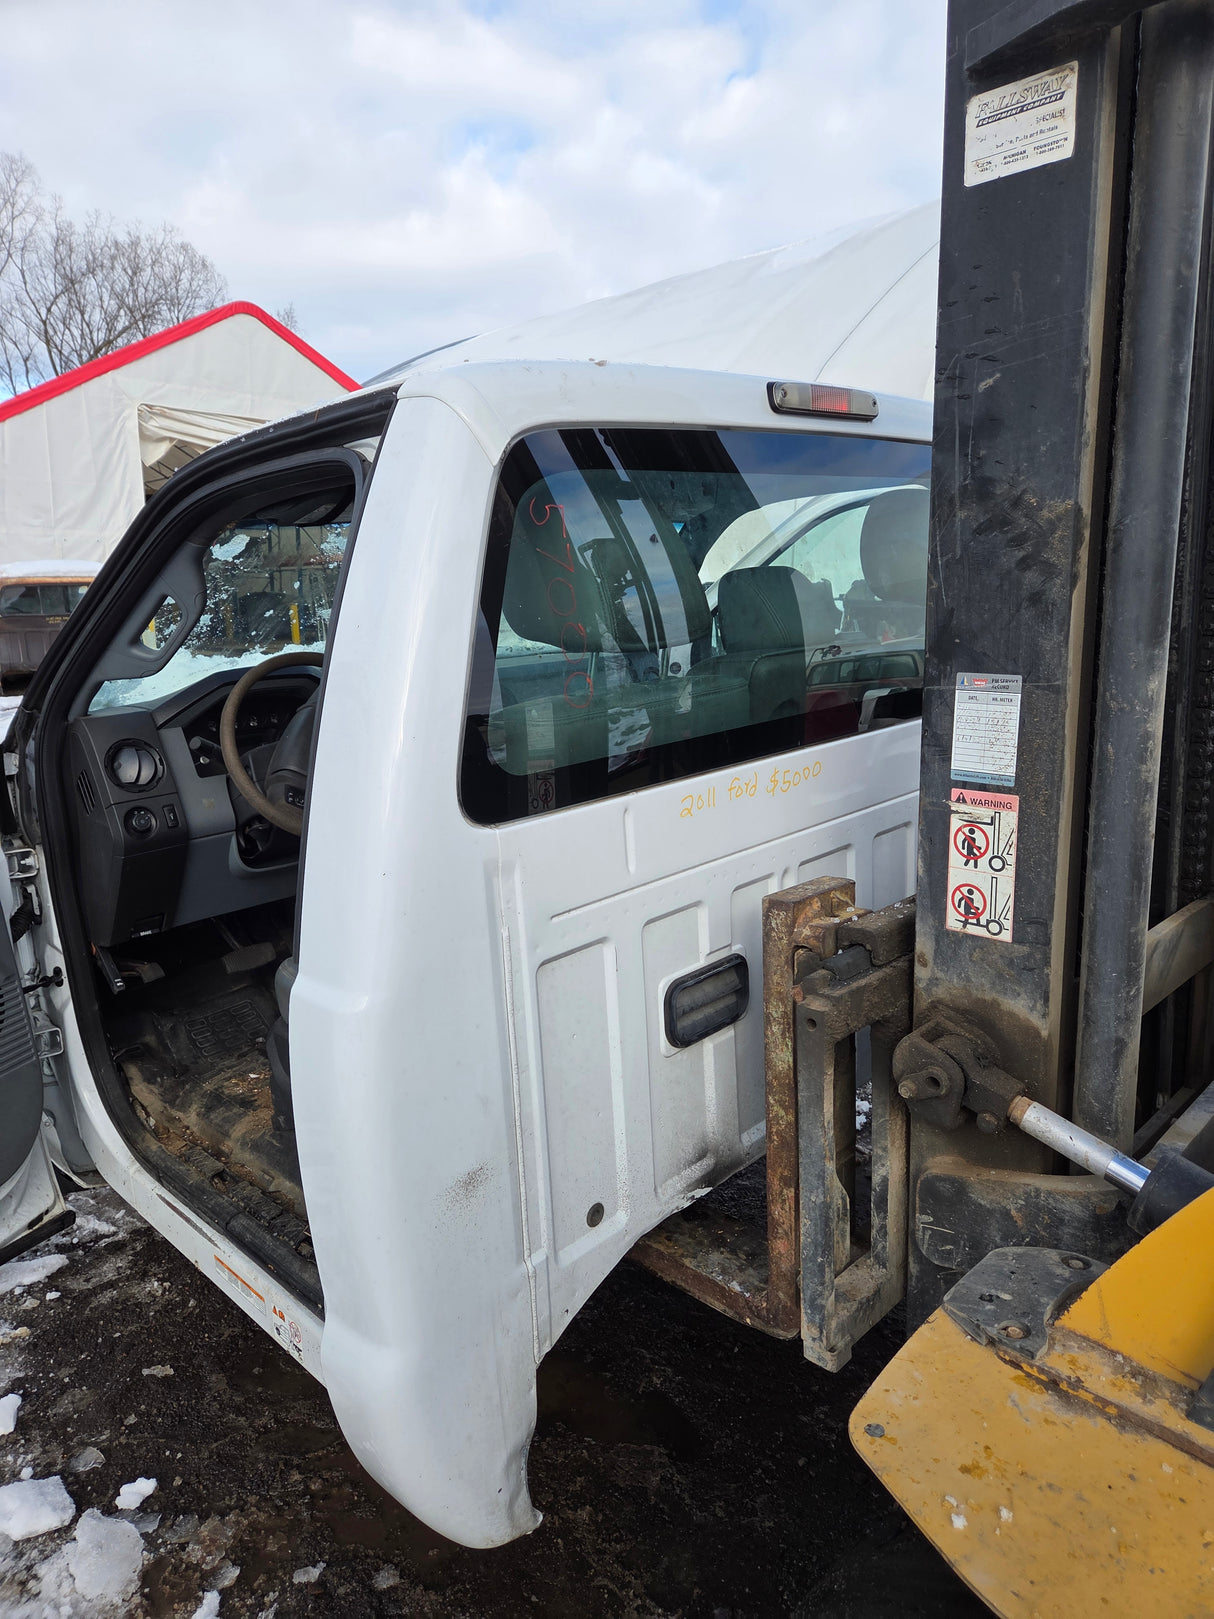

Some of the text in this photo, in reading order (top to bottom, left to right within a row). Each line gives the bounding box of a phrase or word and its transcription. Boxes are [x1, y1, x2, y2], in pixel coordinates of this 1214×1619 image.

[975, 74, 1069, 119] FALLSWAY
[1023, 93, 1063, 112] COMPANY
[680, 786, 715, 818] 2011
[766, 760, 822, 797] $5000
[970, 797, 1013, 810] WARNING
